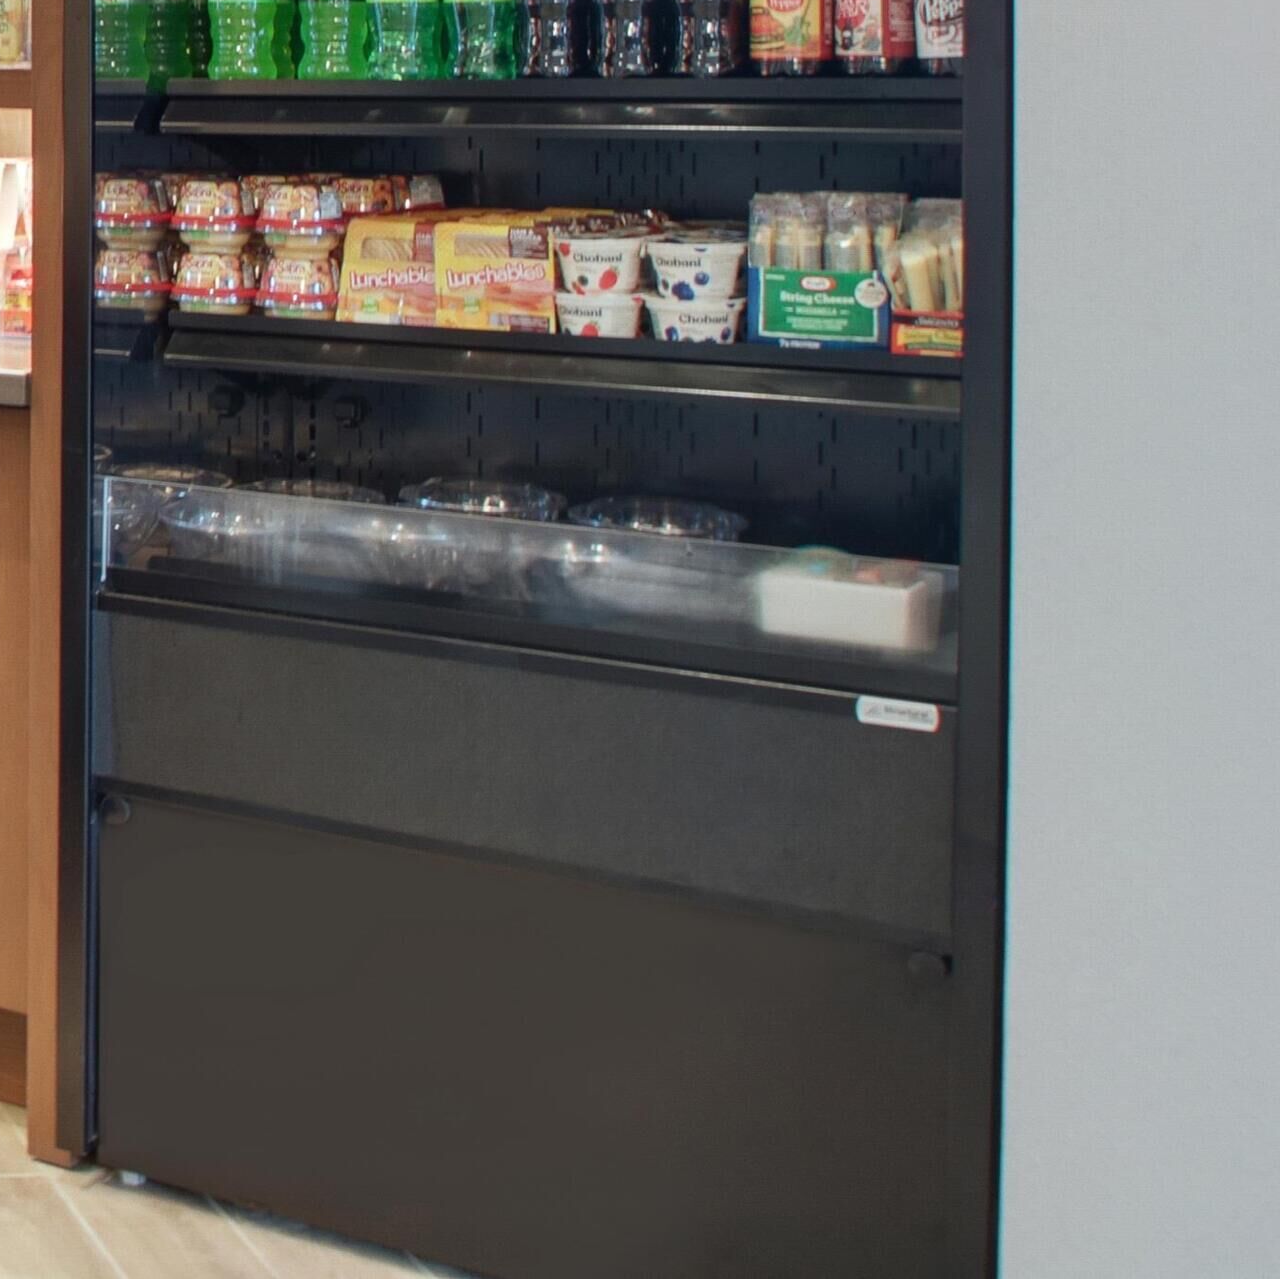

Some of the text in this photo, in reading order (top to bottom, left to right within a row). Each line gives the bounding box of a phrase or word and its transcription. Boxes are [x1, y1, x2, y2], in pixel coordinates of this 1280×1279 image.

[573, 253, 622, 263] Chobani
[446, 263, 545, 289] Lunchables
[780, 291, 855, 306] String Cheese
[679, 314, 729, 325] Chobani
